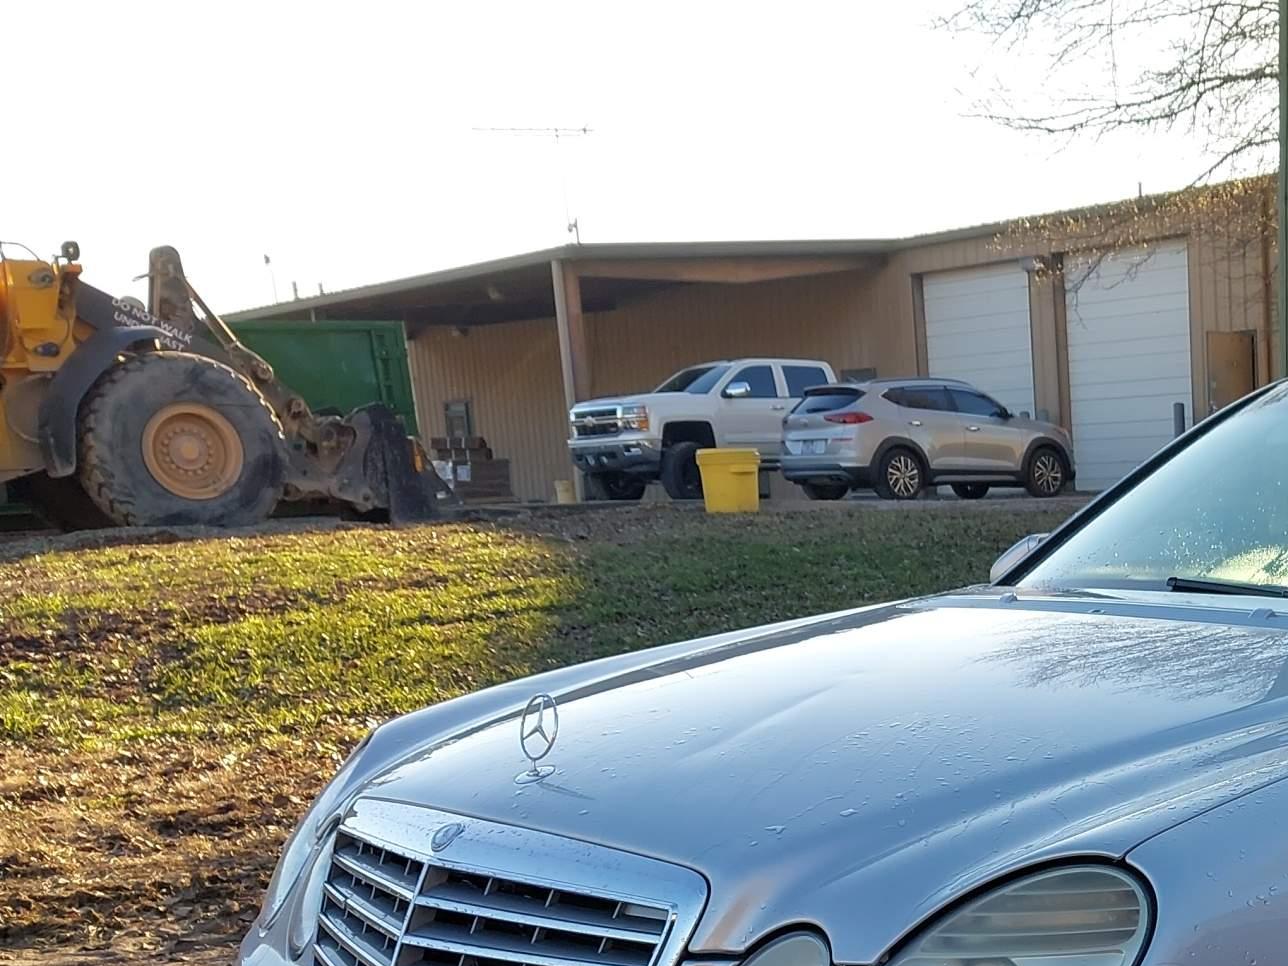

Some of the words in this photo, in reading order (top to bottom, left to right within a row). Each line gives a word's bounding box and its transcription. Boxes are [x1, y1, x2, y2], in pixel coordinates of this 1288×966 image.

[112, 298, 130, 311] DO
[131, 308, 158, 325] NOT
[160, 321, 192, 344] WALK
